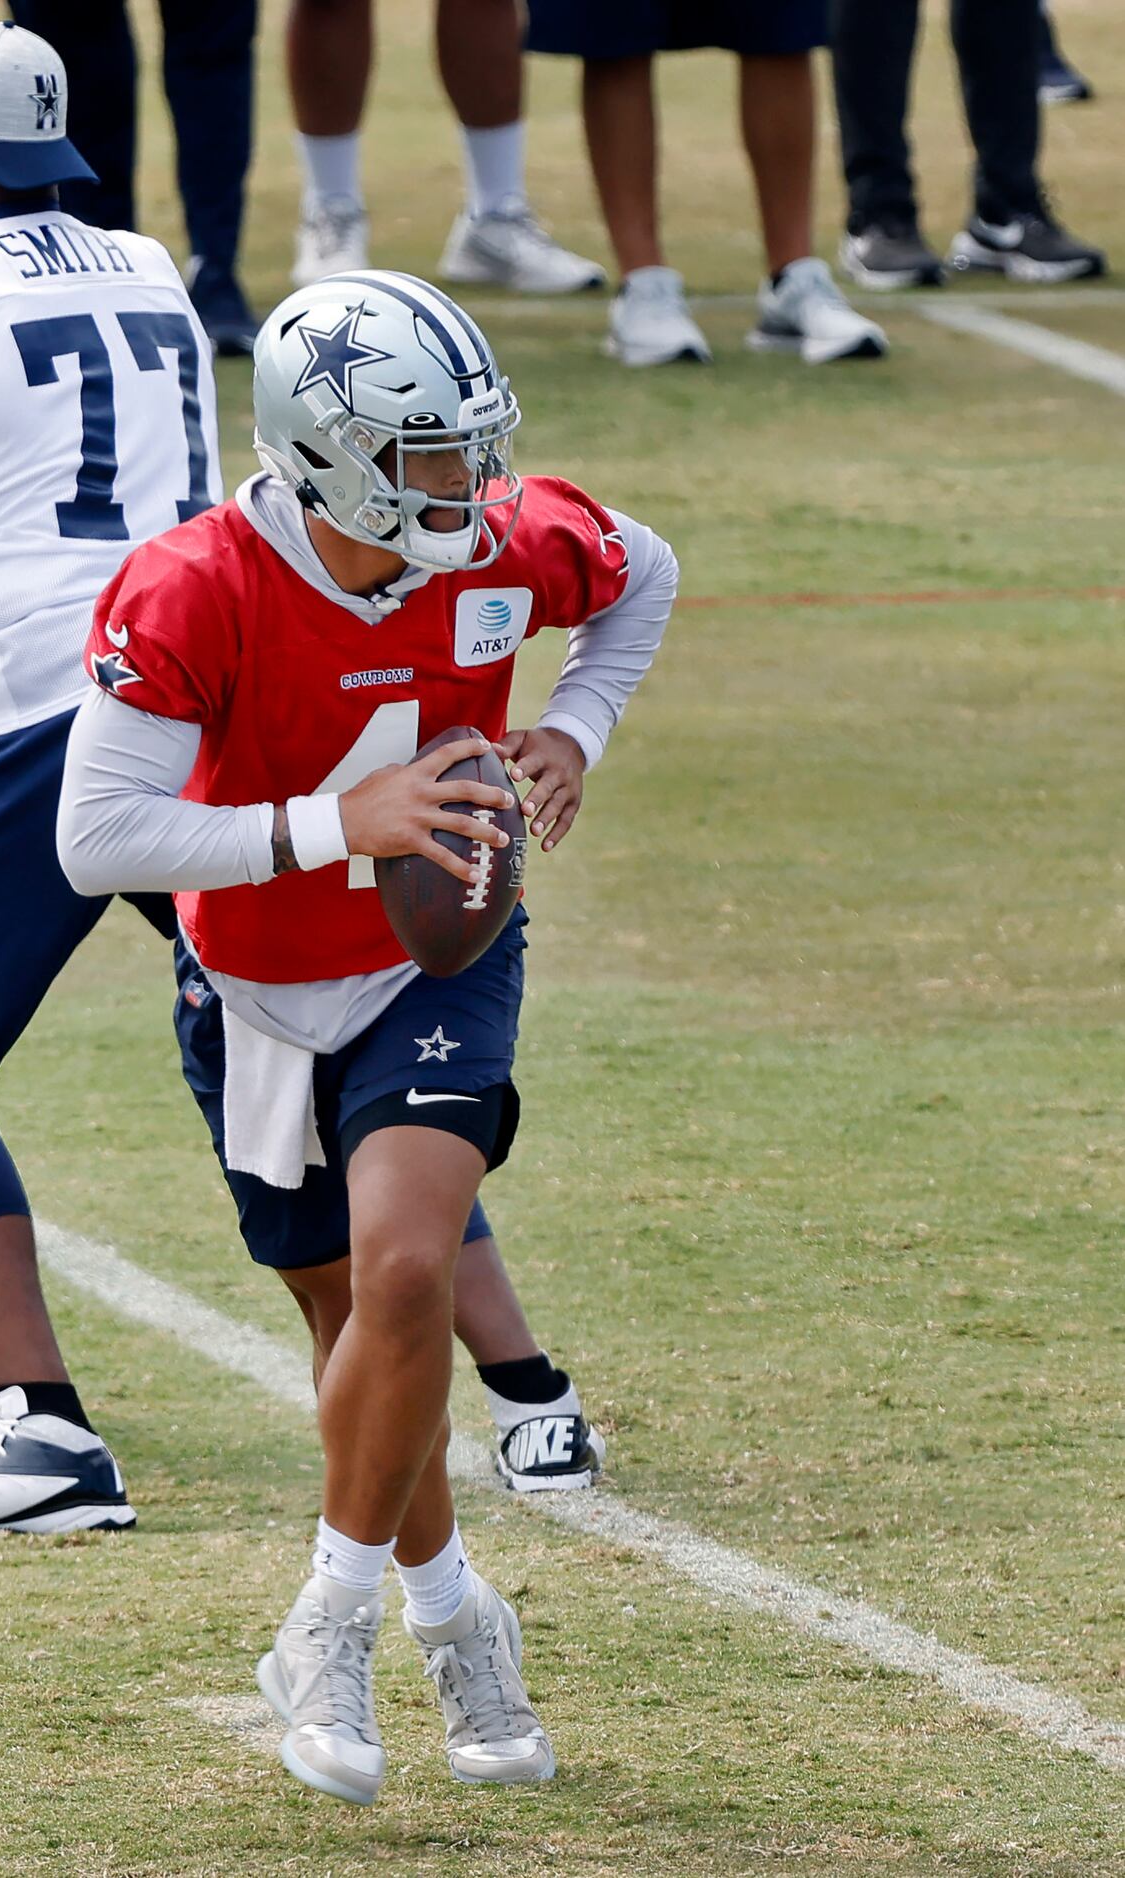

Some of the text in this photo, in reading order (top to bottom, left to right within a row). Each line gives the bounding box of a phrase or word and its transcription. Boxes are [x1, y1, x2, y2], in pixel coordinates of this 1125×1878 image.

[10, 311, 217, 541] 77
[471, 636, 512, 655] AT&T
[340, 667, 414, 690] COWBOYS
